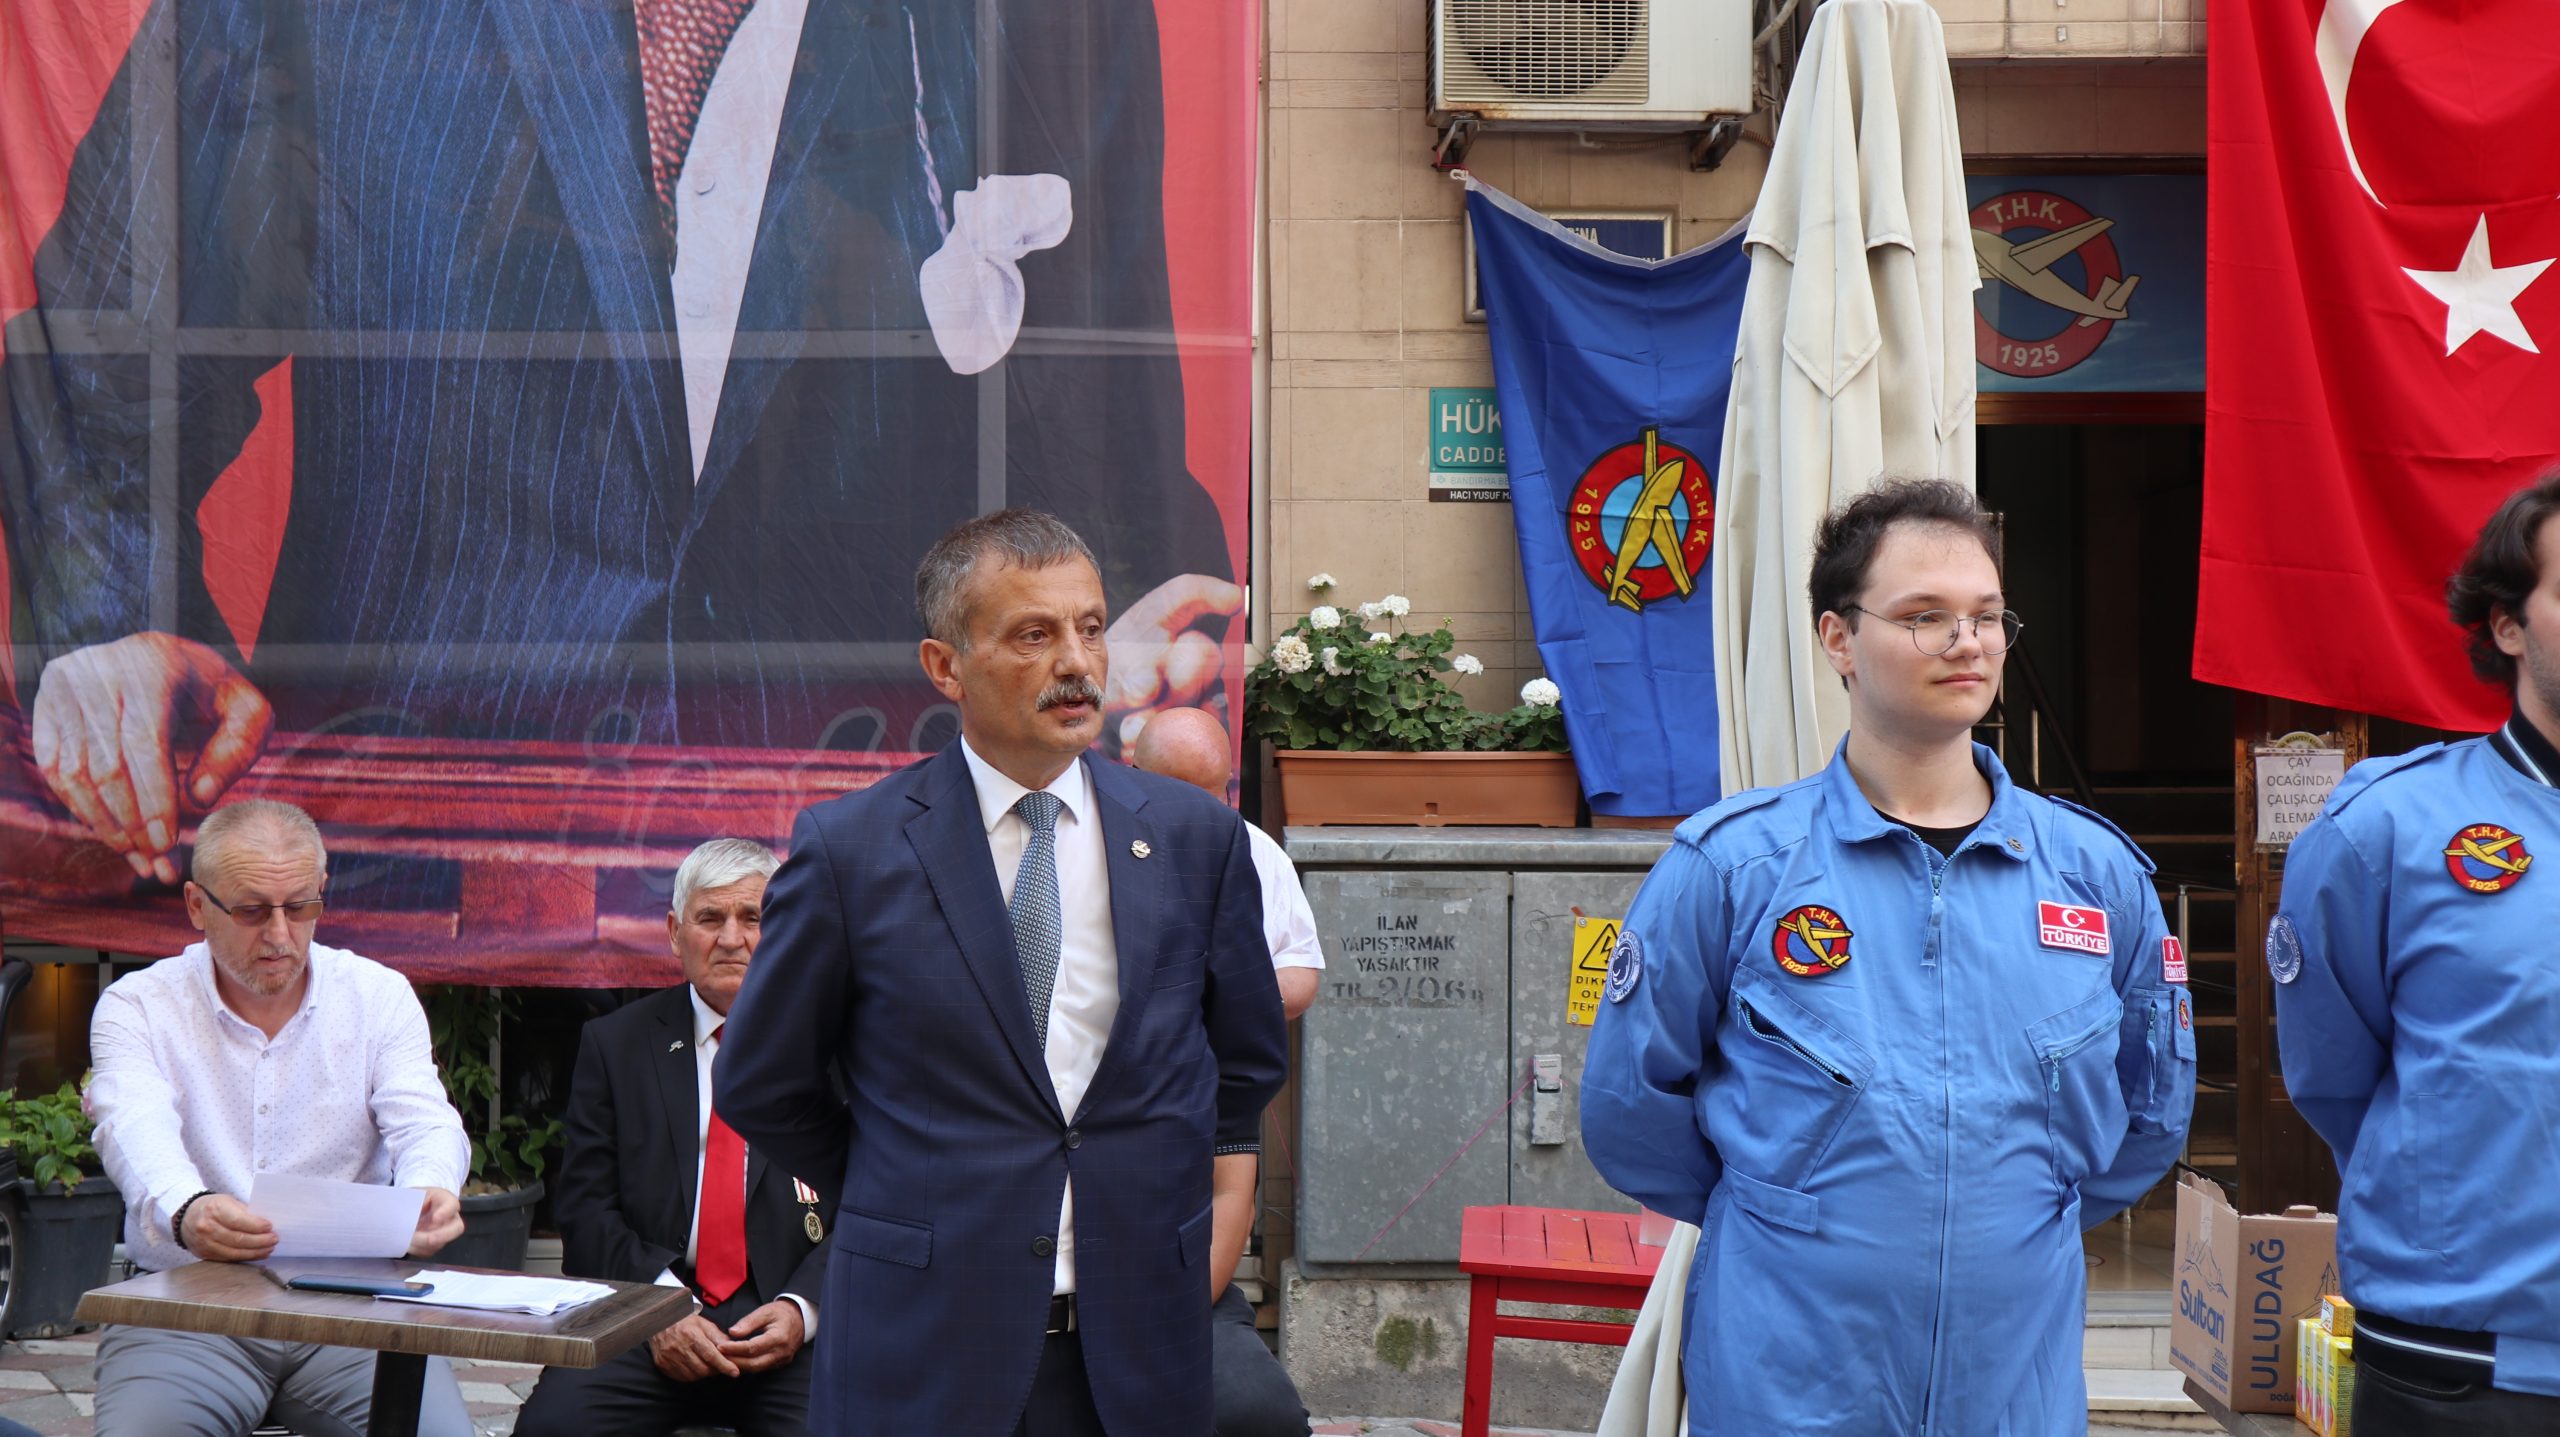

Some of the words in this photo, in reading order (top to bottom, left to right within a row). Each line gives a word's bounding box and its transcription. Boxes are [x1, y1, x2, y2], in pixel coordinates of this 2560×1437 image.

[2000, 344, 2060, 368] 1925
[1441, 398, 1502, 434] HÜK
[1440, 446, 1506, 463] CADDE
[1450, 490, 1471, 500] HACI
[1472, 490, 1501, 500] YUSUF
[1576, 488, 1599, 551] 1925
[2288, 757, 2312, 769] ÇAY
[2266, 773, 2334, 787] OCAĞINDA
[2267, 793, 2329, 807] ÇALIŞACA
[2275, 812, 2320, 824] ELEMA
[2468, 879, 2501, 891] 1925
[1377, 912, 1418, 931] İLAN
[1340, 935, 1456, 954] YAPIŞTIRMAK
[2044, 929, 2107, 951] TÜRKİYE
[1356, 956, 1440, 972] YASAKTIR
[1781, 956, 1810, 975] 1925
[1332, 982, 1362, 998] TR
[2180, 1279, 2225, 1344] Sultan
[2250, 1238, 2285, 1389] ULUDAĞ
